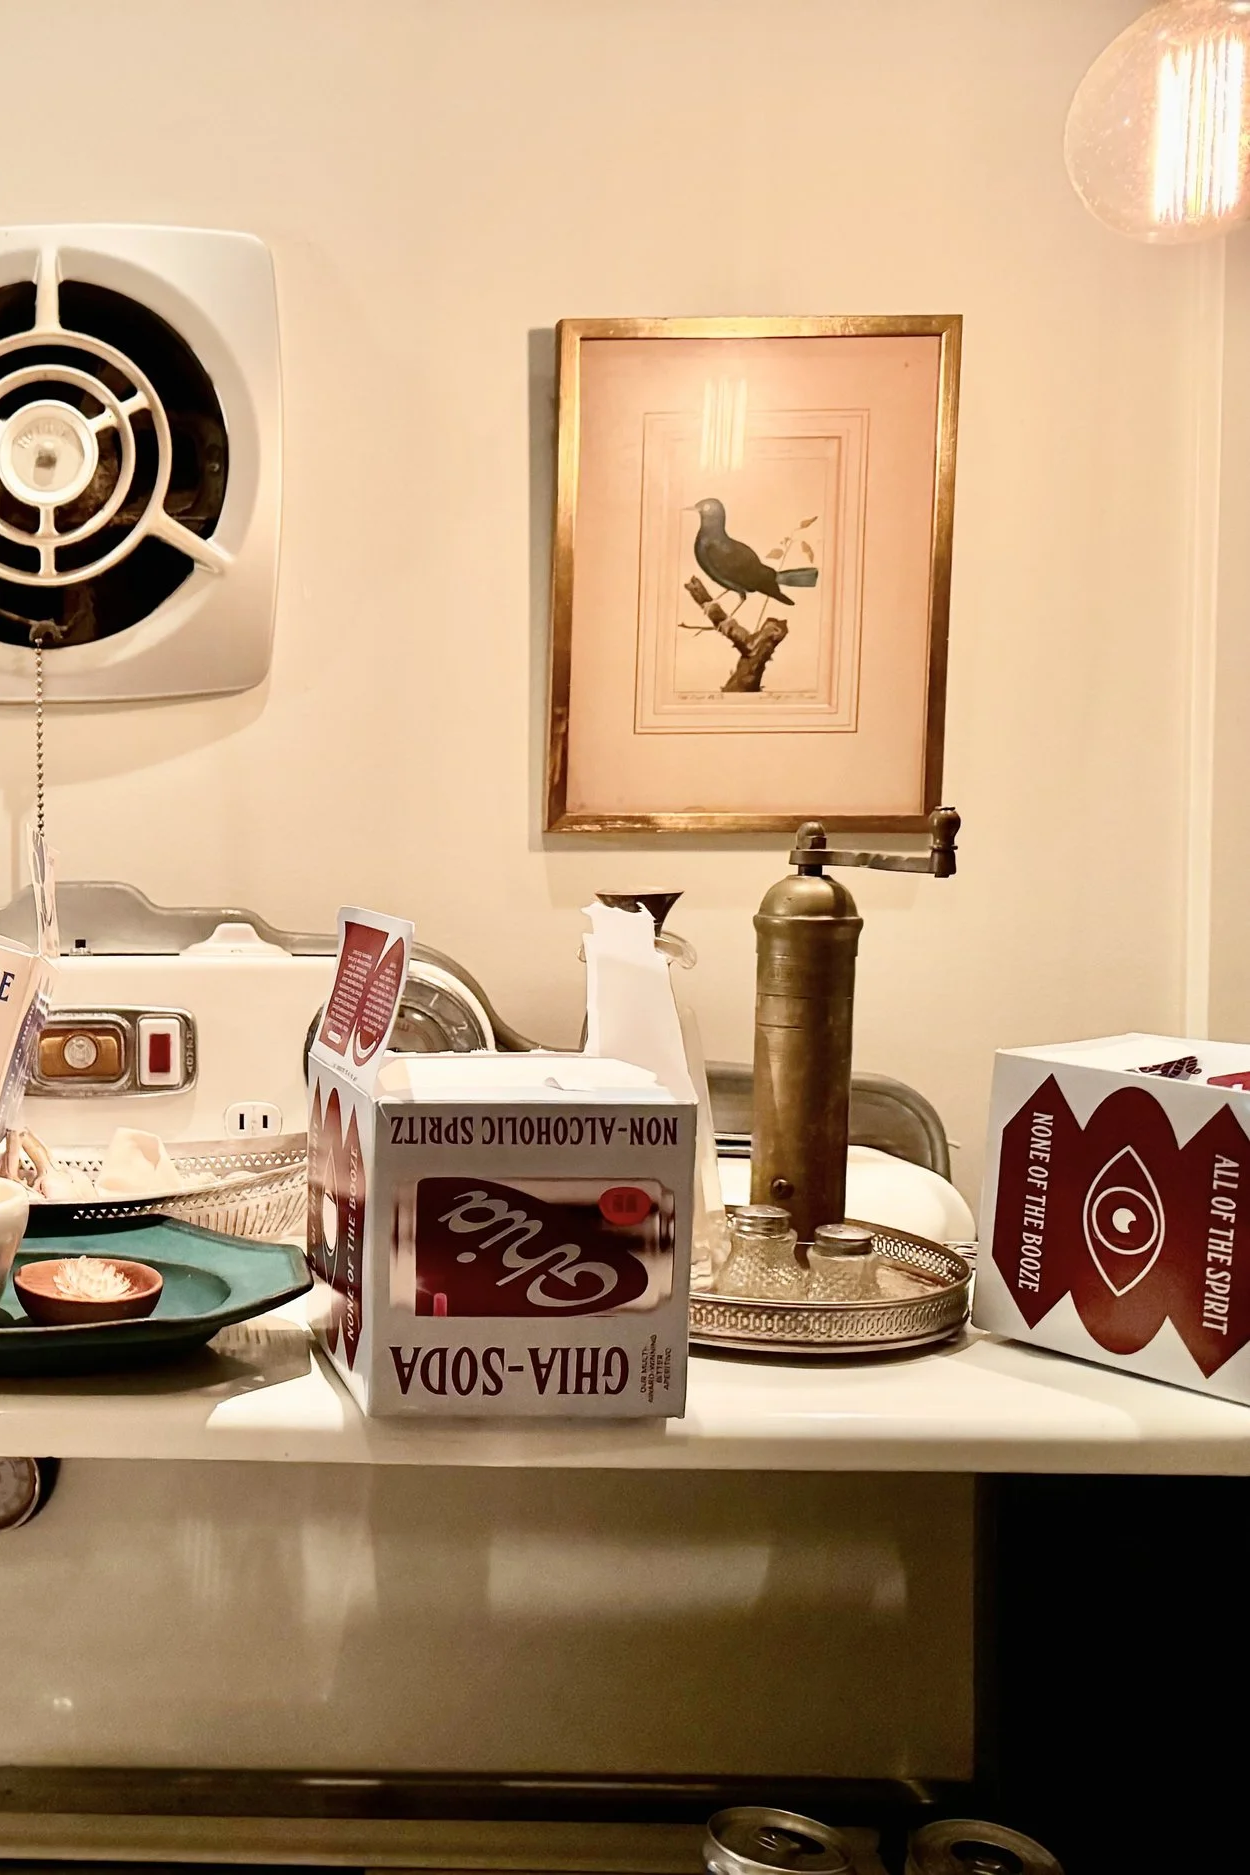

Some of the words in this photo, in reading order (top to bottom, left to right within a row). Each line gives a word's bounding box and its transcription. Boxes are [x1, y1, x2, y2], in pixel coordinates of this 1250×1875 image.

[390, 1116, 474, 1145] SPRITZ
[482, 1116, 678, 1146] NON-ALCOHOLIC
[1029, 1111, 1055, 1163] NONE
[349, 1147, 359, 1211] BOOZE
[1026, 1166, 1048, 1192] OF
[1213, 1154, 1239, 1190] ALL
[1024, 1194, 1047, 1232] THE
[1210, 1195, 1236, 1224] OF
[346, 1217, 356, 1252] THE
[437, 1190, 618, 1308] Ghia
[1207, 1227, 1235, 1265] THE
[1018, 1231, 1043, 1292] BOOZE
[346, 1284, 356, 1341] NONE
[1203, 1266, 1232, 1335] SPIRIT
[390, 1346, 630, 1396] GHIA-SODA
